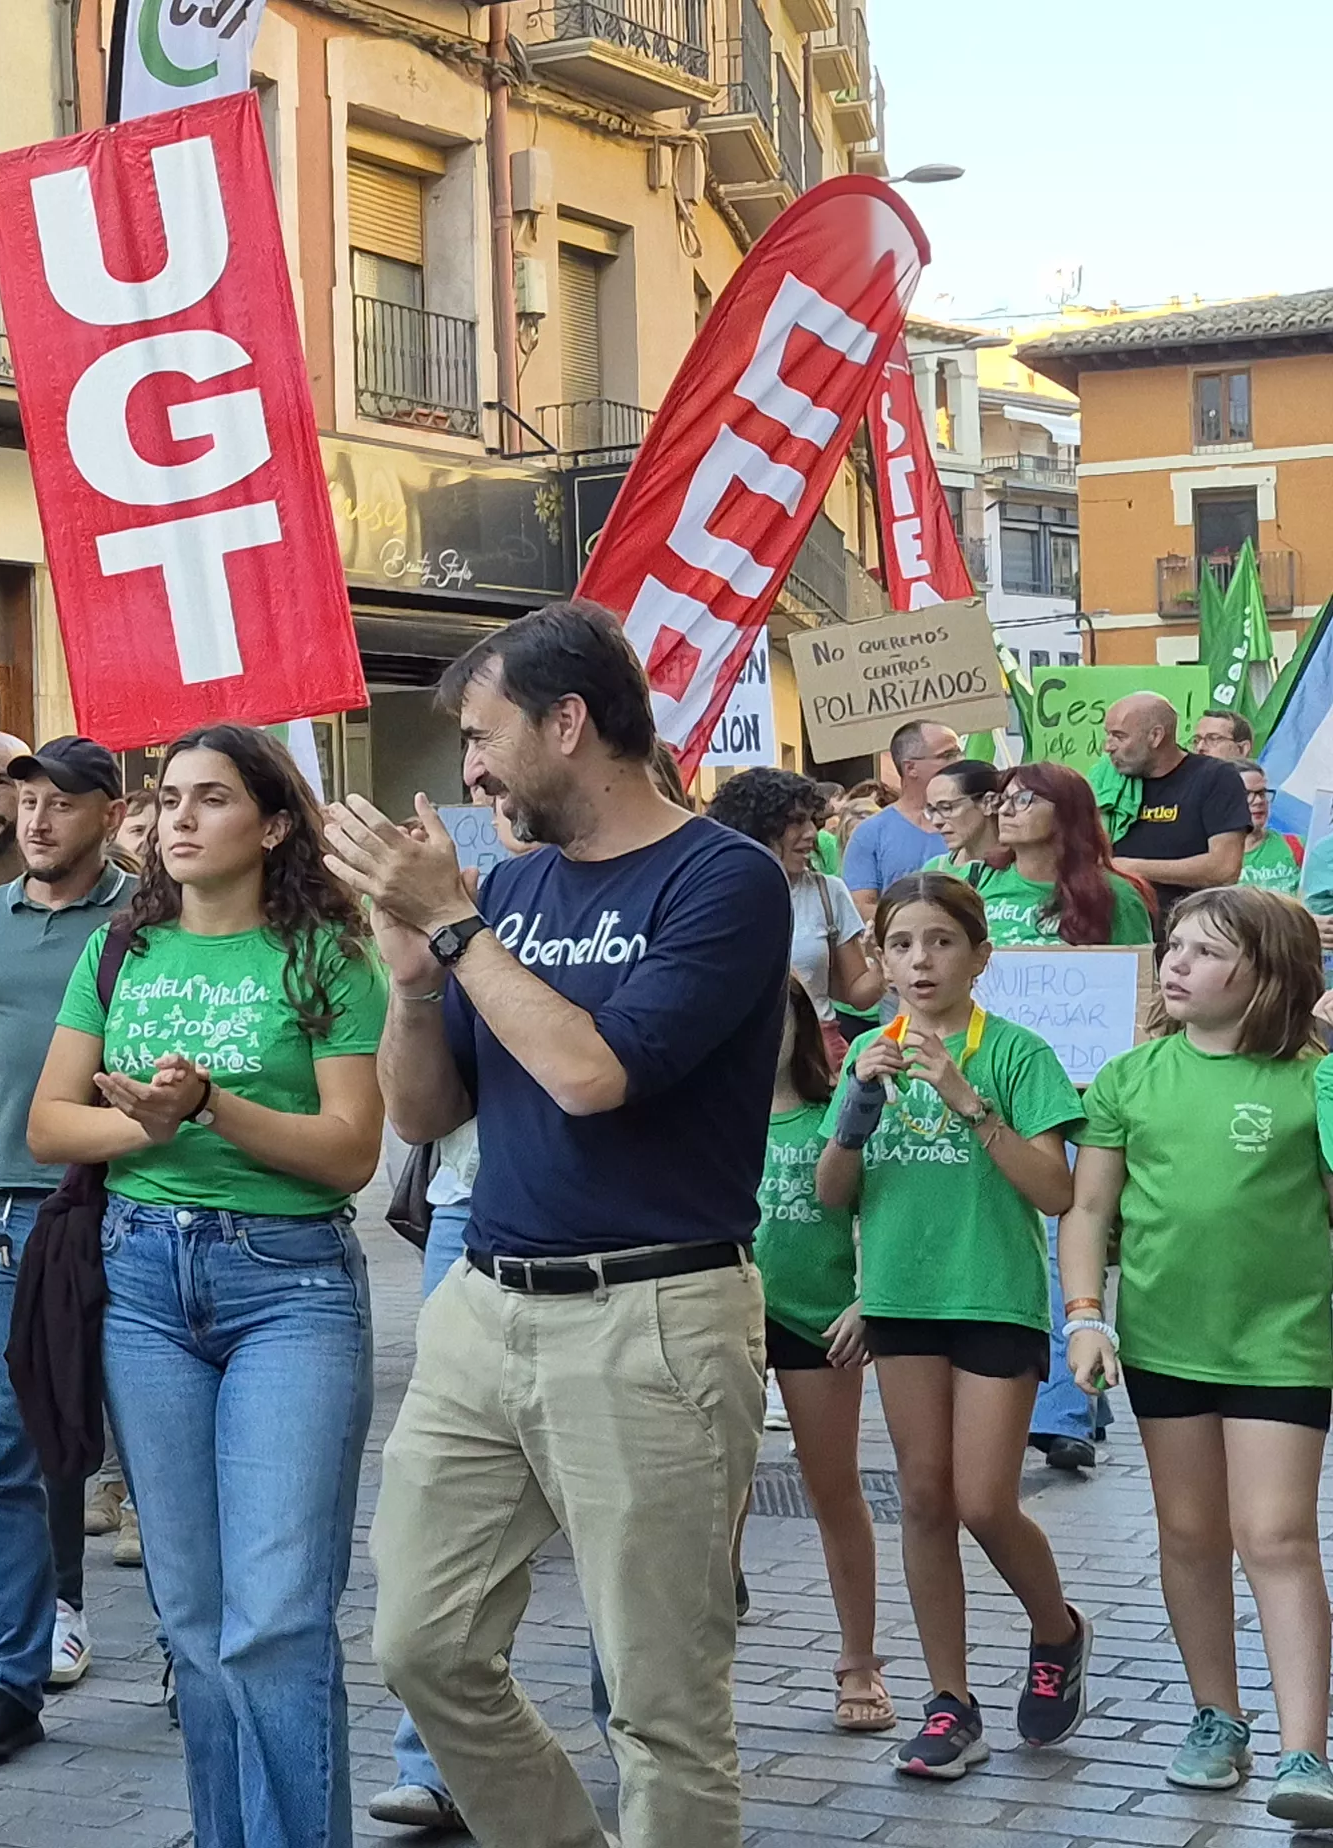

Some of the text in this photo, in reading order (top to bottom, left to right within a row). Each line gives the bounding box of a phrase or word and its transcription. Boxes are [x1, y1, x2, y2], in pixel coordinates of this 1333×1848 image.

[29, 136, 283, 686] UGT
[812, 625, 950, 667] No QUEREMOS
[862, 655, 933, 681] CENTROS
[519, 910, 648, 967] benetton
[120, 978, 194, 1001] ESCUELA
[127, 1018, 248, 1039] DE TOD@S
